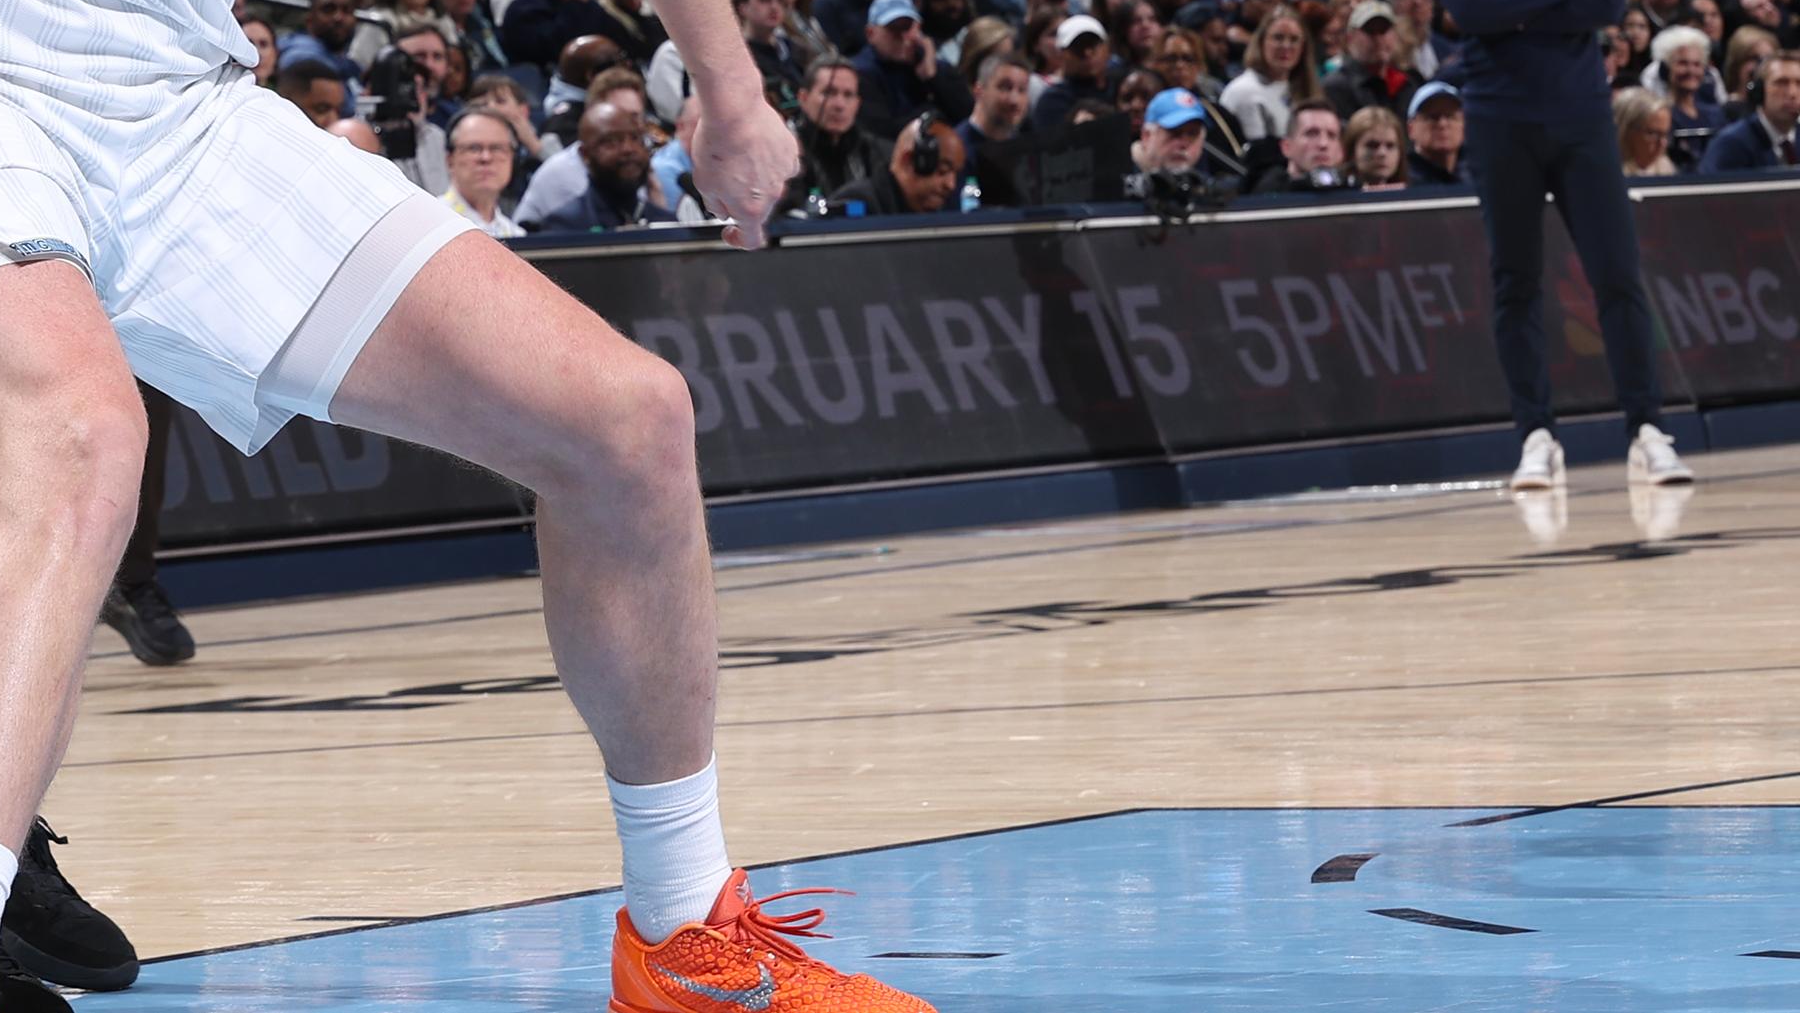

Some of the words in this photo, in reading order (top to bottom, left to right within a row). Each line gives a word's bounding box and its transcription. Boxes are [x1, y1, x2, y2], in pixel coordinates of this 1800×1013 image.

[633, 292, 1058, 434] BRUARY
[1072, 285, 1191, 399] 15
[1656, 268, 1800, 349] NBC
